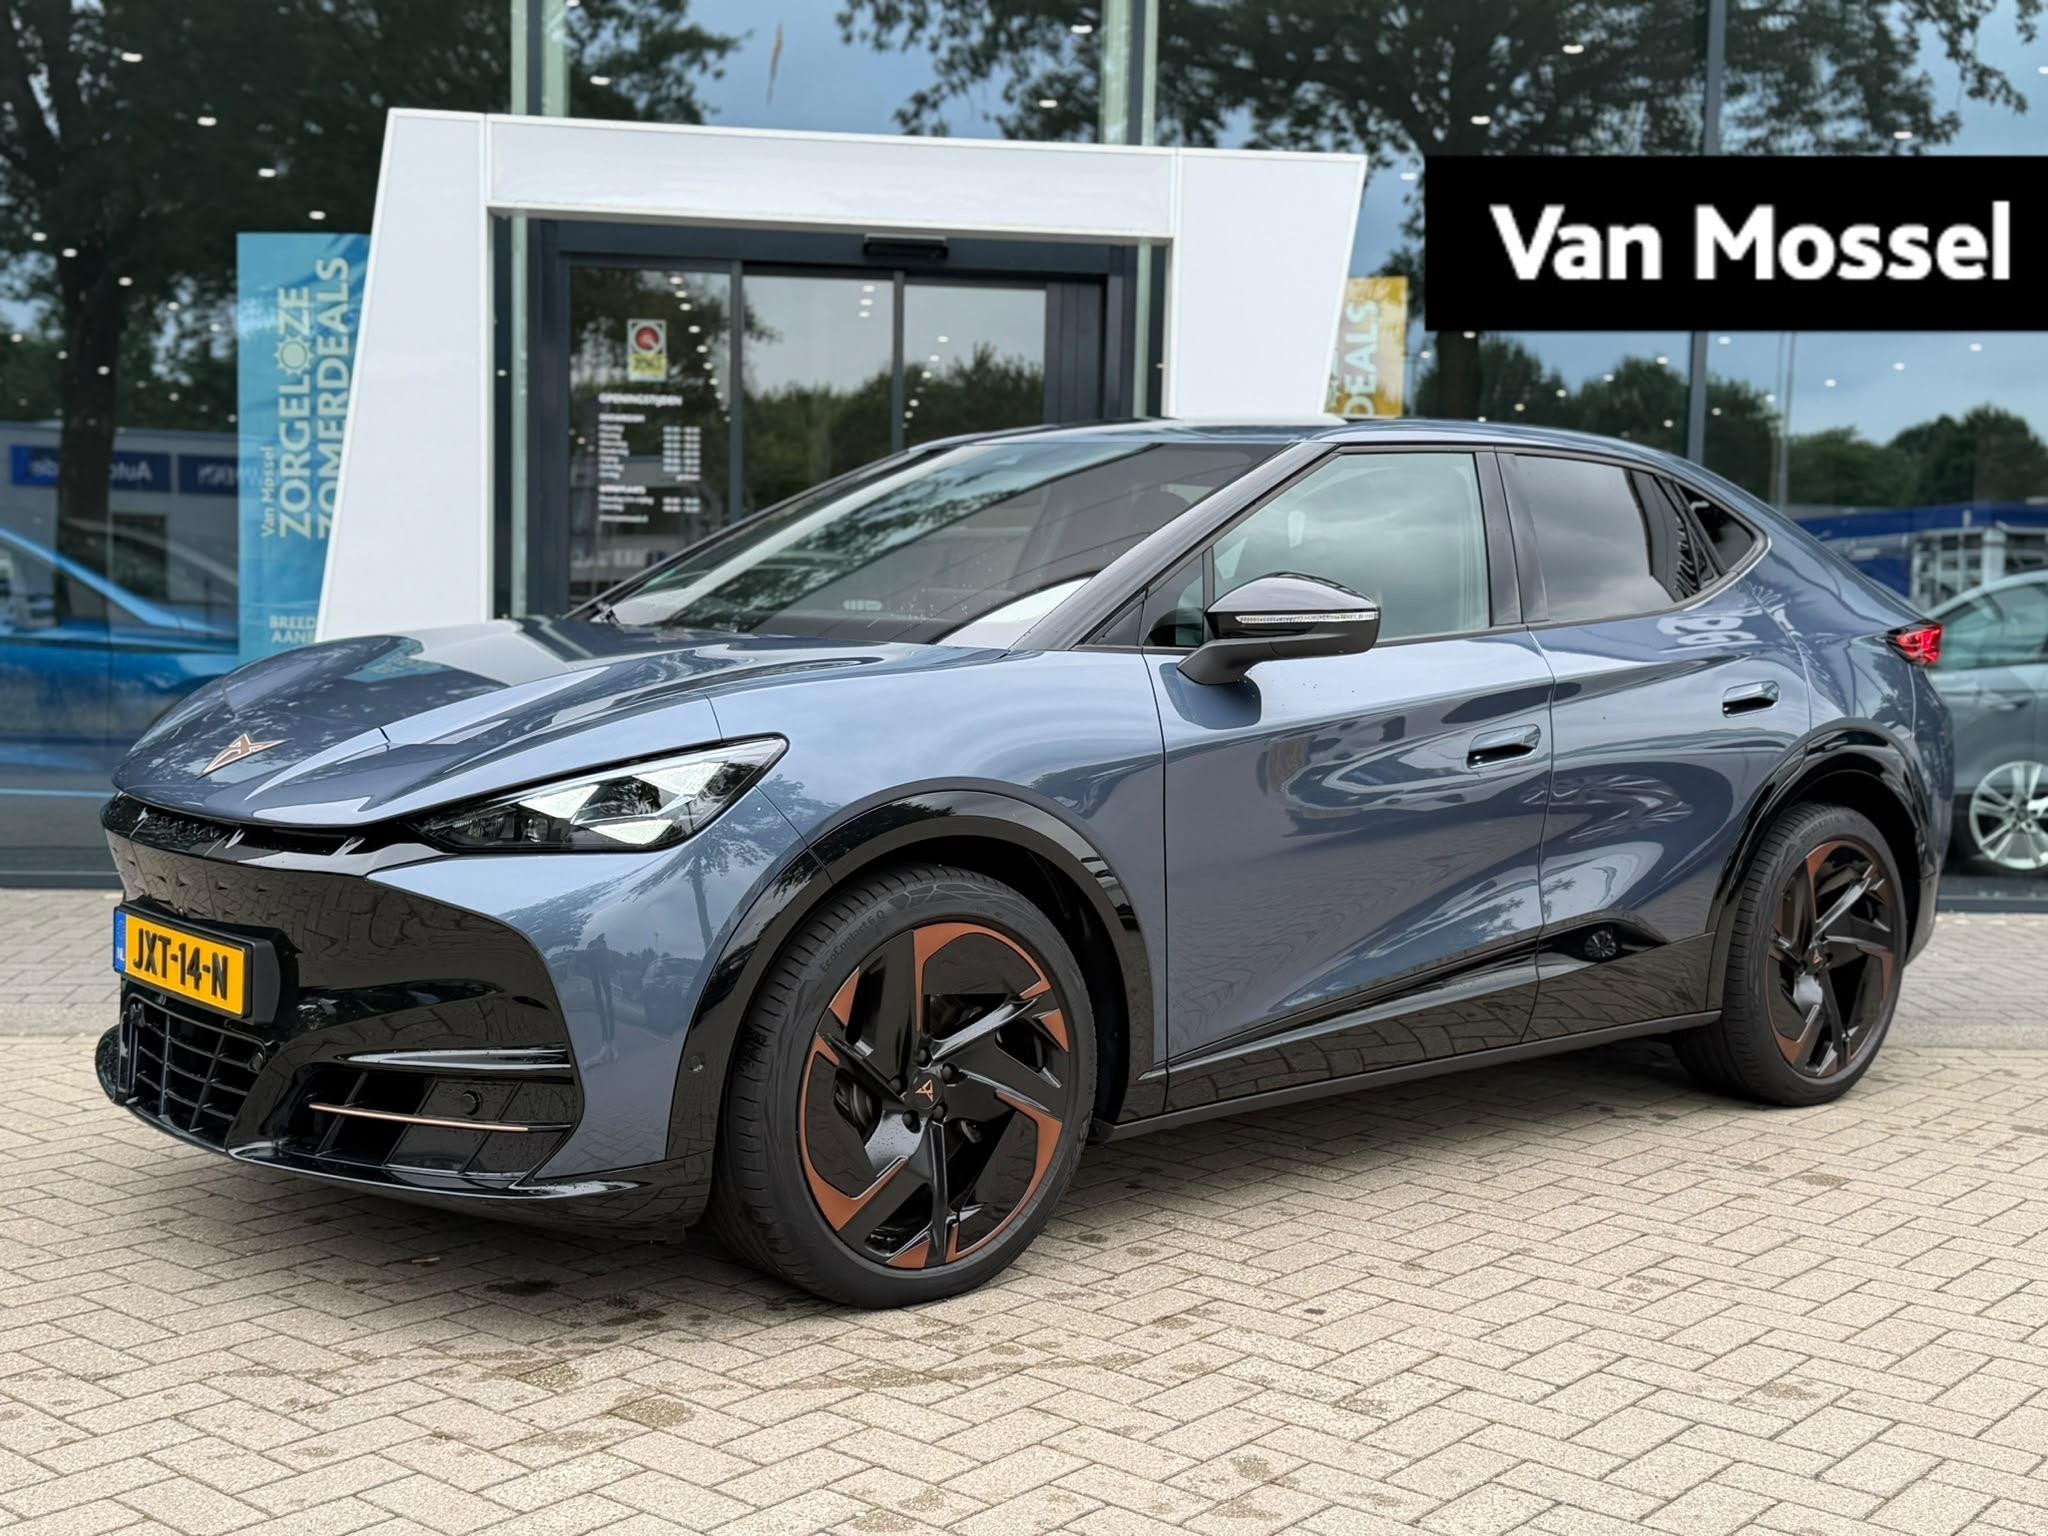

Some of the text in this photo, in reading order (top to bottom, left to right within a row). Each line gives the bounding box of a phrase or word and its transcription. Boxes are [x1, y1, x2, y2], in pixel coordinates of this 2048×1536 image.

[260, 446, 275, 538] Van Mossel
[132, 927, 229, 1001] JXT-14-N
